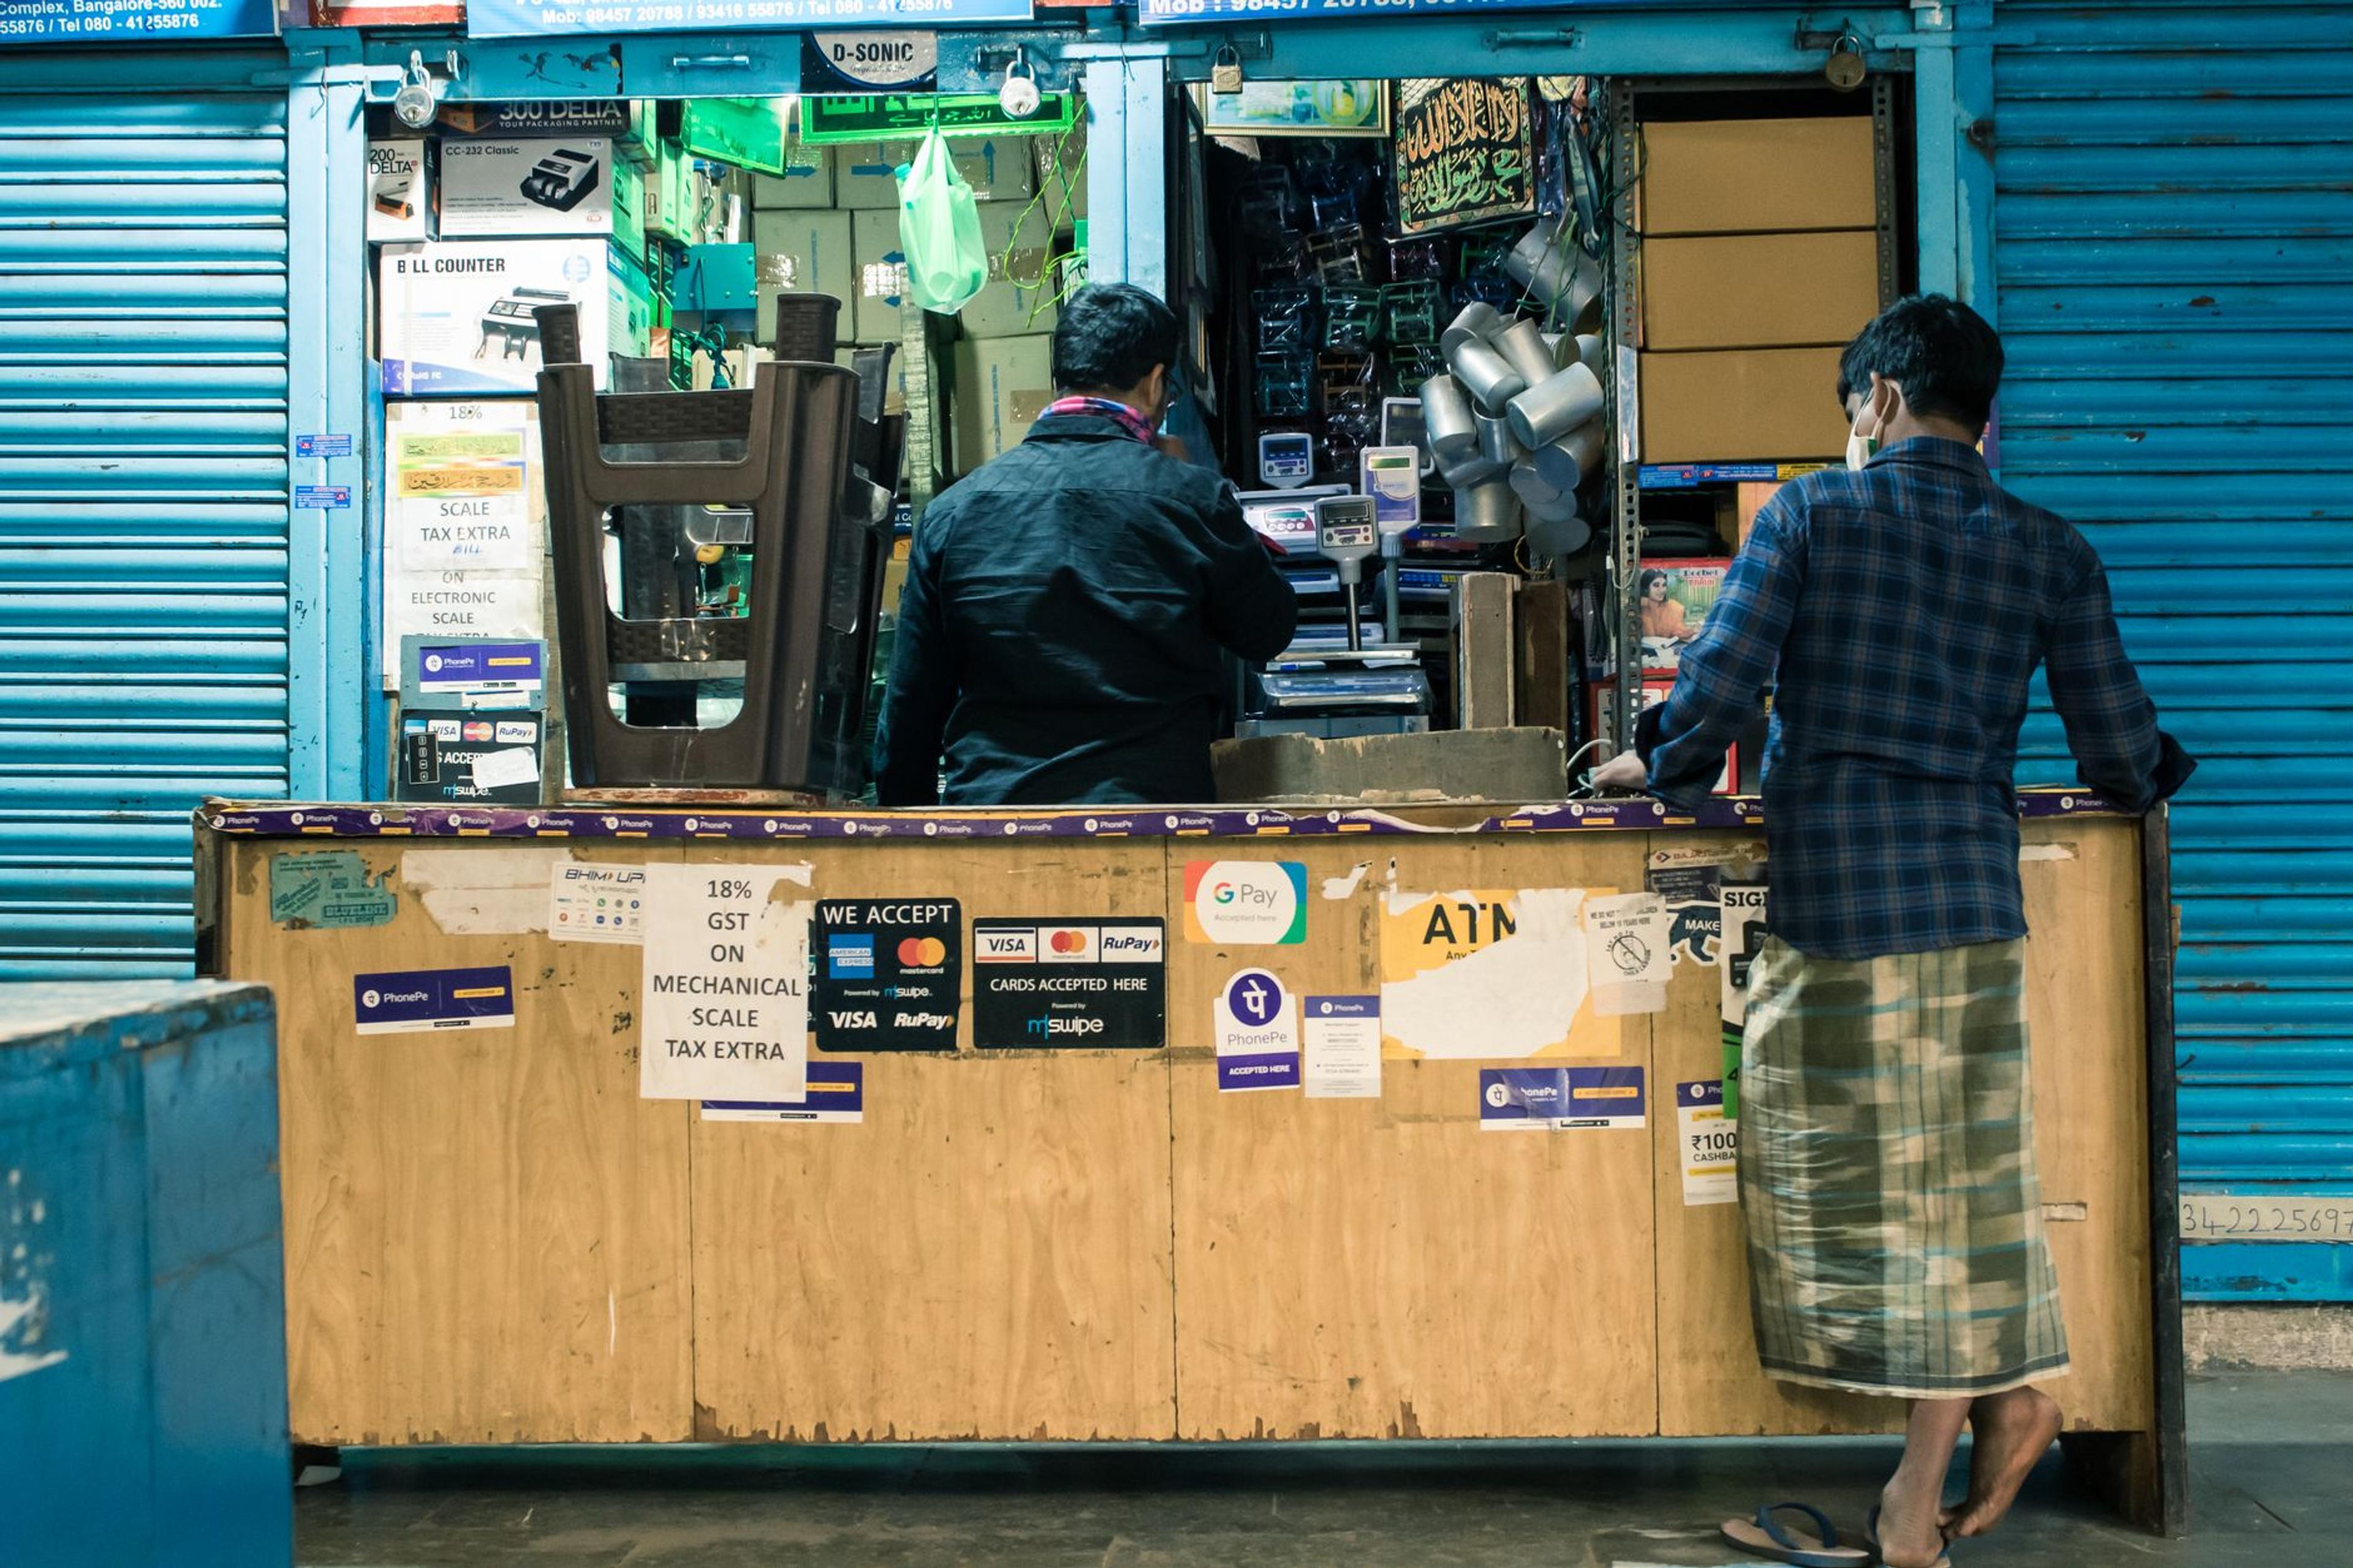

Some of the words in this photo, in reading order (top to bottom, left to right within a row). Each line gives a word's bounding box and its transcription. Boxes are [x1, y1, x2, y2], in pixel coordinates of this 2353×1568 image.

[586, 7, 632, 23] 98457
[637, 6, 683, 21] 20788
[697, 4, 743, 20] 93416
[748, 2, 794, 18] 55876
[808, 1, 831, 15] Tel
[835, 0, 862, 15] 080
[58, 18, 80, 32] Tel
[85, 17, 112, 31] 080
[833, 42, 914, 62] D-SONIC
[499, 100, 542, 120] 300
[369, 149, 395, 162] 200
[445, 146, 482, 156] CC-232
[485, 145, 520, 155] Classic
[369, 161, 413, 175] DELTA
[397, 259, 430, 274] BLL
[435, 258, 506, 273] COUNTER
[440, 502, 490, 517] SCALE
[420, 527, 452, 542] TAX
[457, 525, 510, 540] EXTRA
[442, 570, 464, 584] ON
[411, 591, 496, 605] ELECTRONIC
[432, 612, 475, 624] SCALE
[565, 868, 608, 881] BHIM
[707, 880, 752, 899] 18%
[1241, 884, 1278, 909] Pay
[708, 912, 749, 931] GST
[822, 906, 858, 925] WE
[866, 904, 953, 924] ACCEPT
[1214, 913, 1255, 923] Accepted
[1257, 914, 1277, 923] here
[988, 938, 1026, 952] VISA
[1103, 936, 1153, 952] RuPay
[710, 944, 745, 963] ON
[653, 974, 801, 997] MECHANICAL
[990, 979, 1036, 991] CARDS
[1038, 979, 1107, 991] ACCEPTED
[1113, 978, 1148, 991] HERE
[384, 990, 429, 1003] PhonePe
[1334, 1004, 1365, 1012] PhonePe
[692, 1007, 759, 1028] SCALE
[828, 1011, 877, 1029] VISA
[893, 1012, 948, 1031] RuPay
[1227, 1031, 1288, 1047] PhonePe
[665, 1039, 706, 1059] TAX
[714, 1041, 785, 1061] EXTRA
[1229, 1065, 1268, 1075] ACCEPTED
[1269, 1064, 1291, 1073] HERE
[1692, 1152, 1737, 1163] CASHBA
